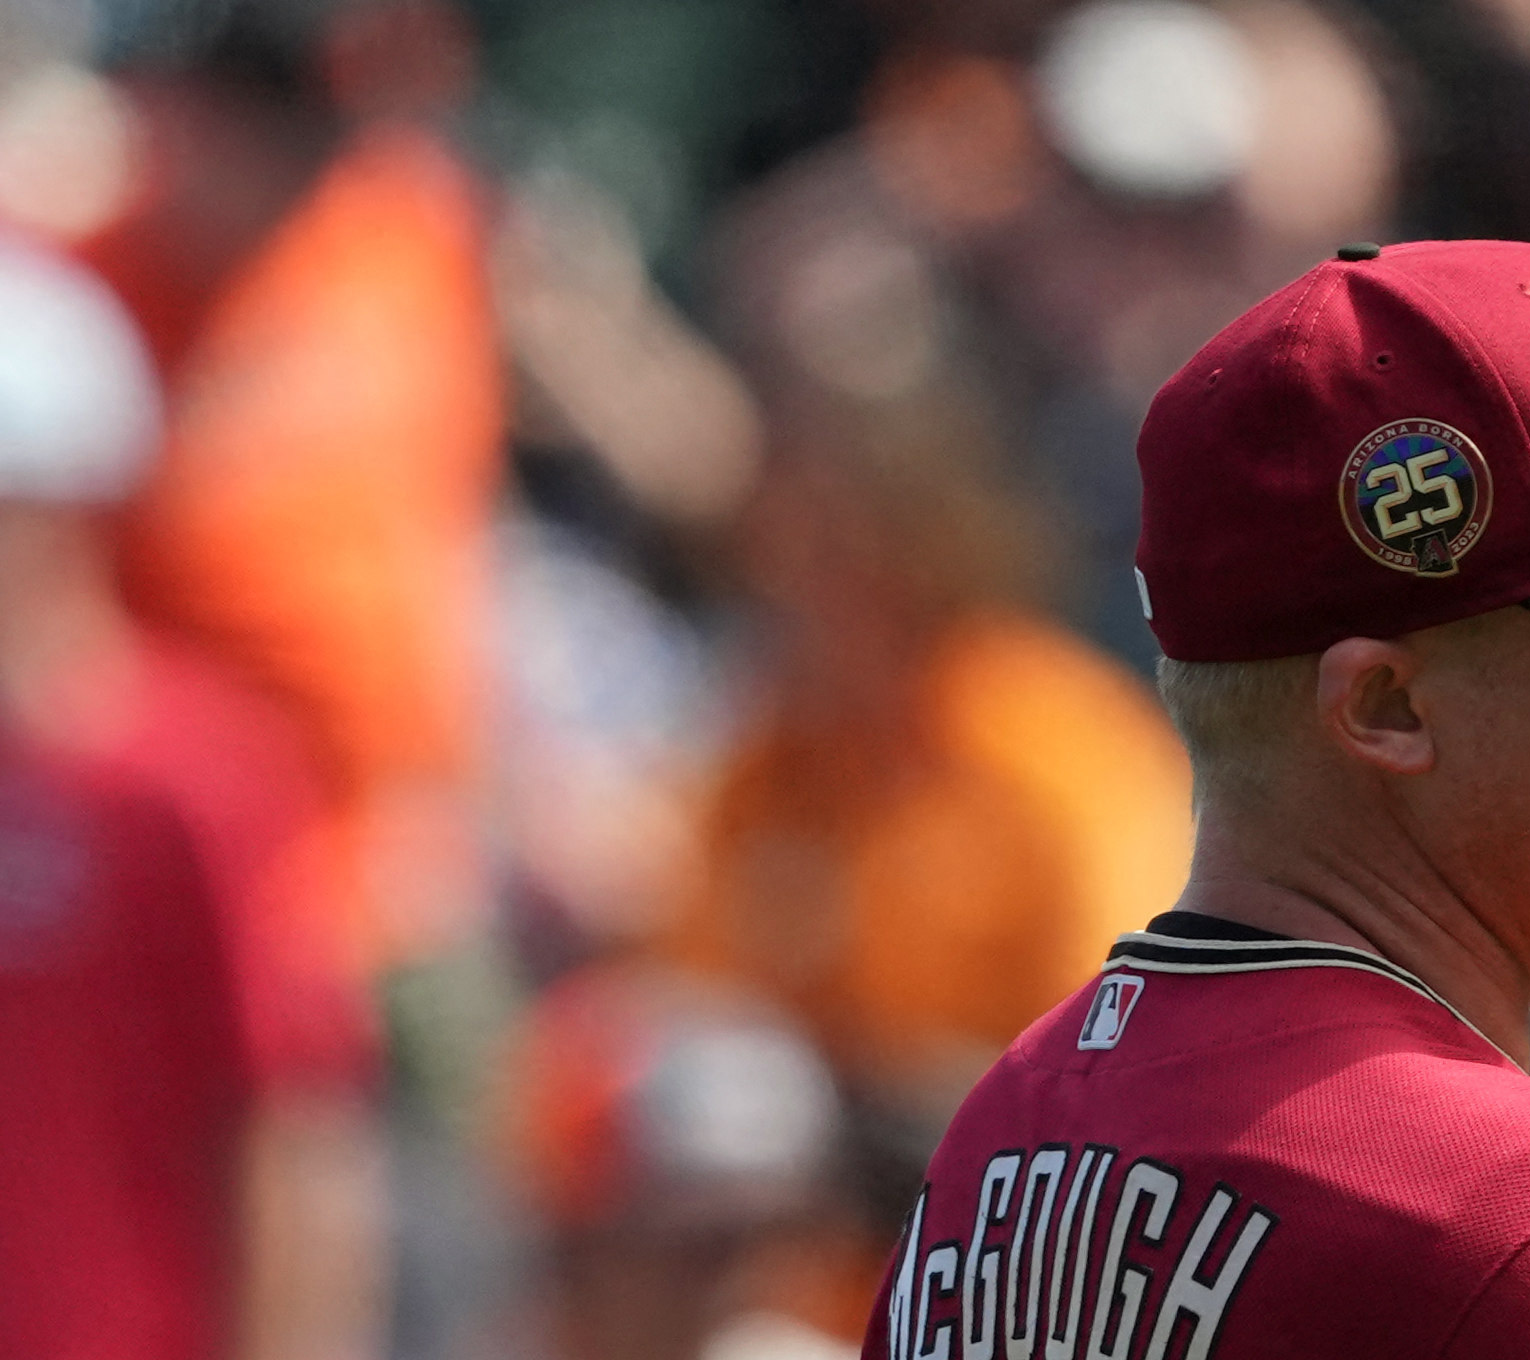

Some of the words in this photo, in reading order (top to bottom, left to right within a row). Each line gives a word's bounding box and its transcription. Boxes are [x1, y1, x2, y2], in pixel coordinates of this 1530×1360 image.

[1348, 424, 1409, 479] ARIZONA
[1418, 423, 1463, 447] BORN
[1366, 448, 1463, 541] 25
